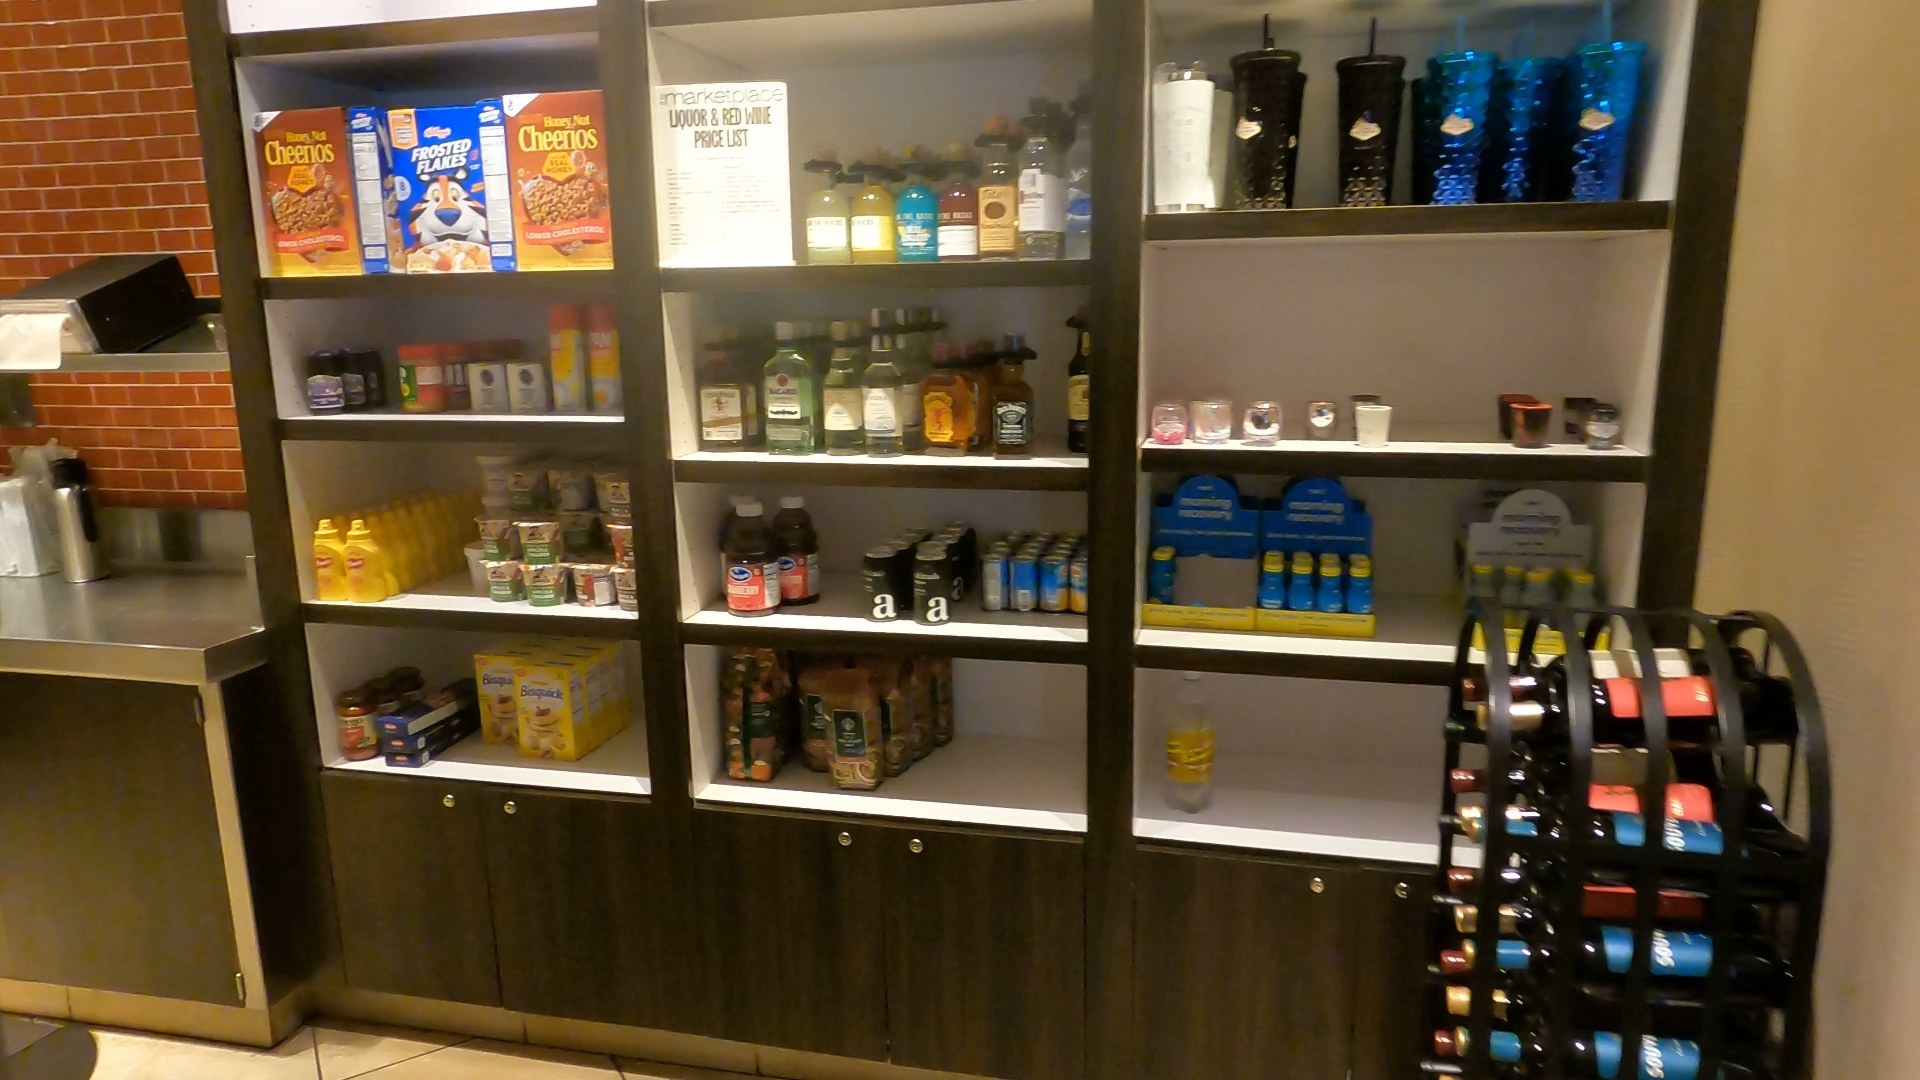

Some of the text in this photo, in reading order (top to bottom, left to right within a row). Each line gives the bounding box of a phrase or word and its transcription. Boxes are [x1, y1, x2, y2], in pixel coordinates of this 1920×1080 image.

[665, 88, 783, 106] marketplace
[544, 114, 591, 129] Honey Nut
[669, 106, 772, 130] LIQUOR & RED WINE
[518, 125, 599, 152] Cheerios
[694, 129, 749, 148] PRICE LIST
[265, 139, 335, 166] Cheerios
[411, 138, 472, 163] FROSTED
[416, 152, 468, 175] FLAKES
[873, 594, 897, 619] a
[926, 597, 949, 622] a
[482, 673, 514, 688] Bisqu
[520, 684, 564, 700] Bisquick
